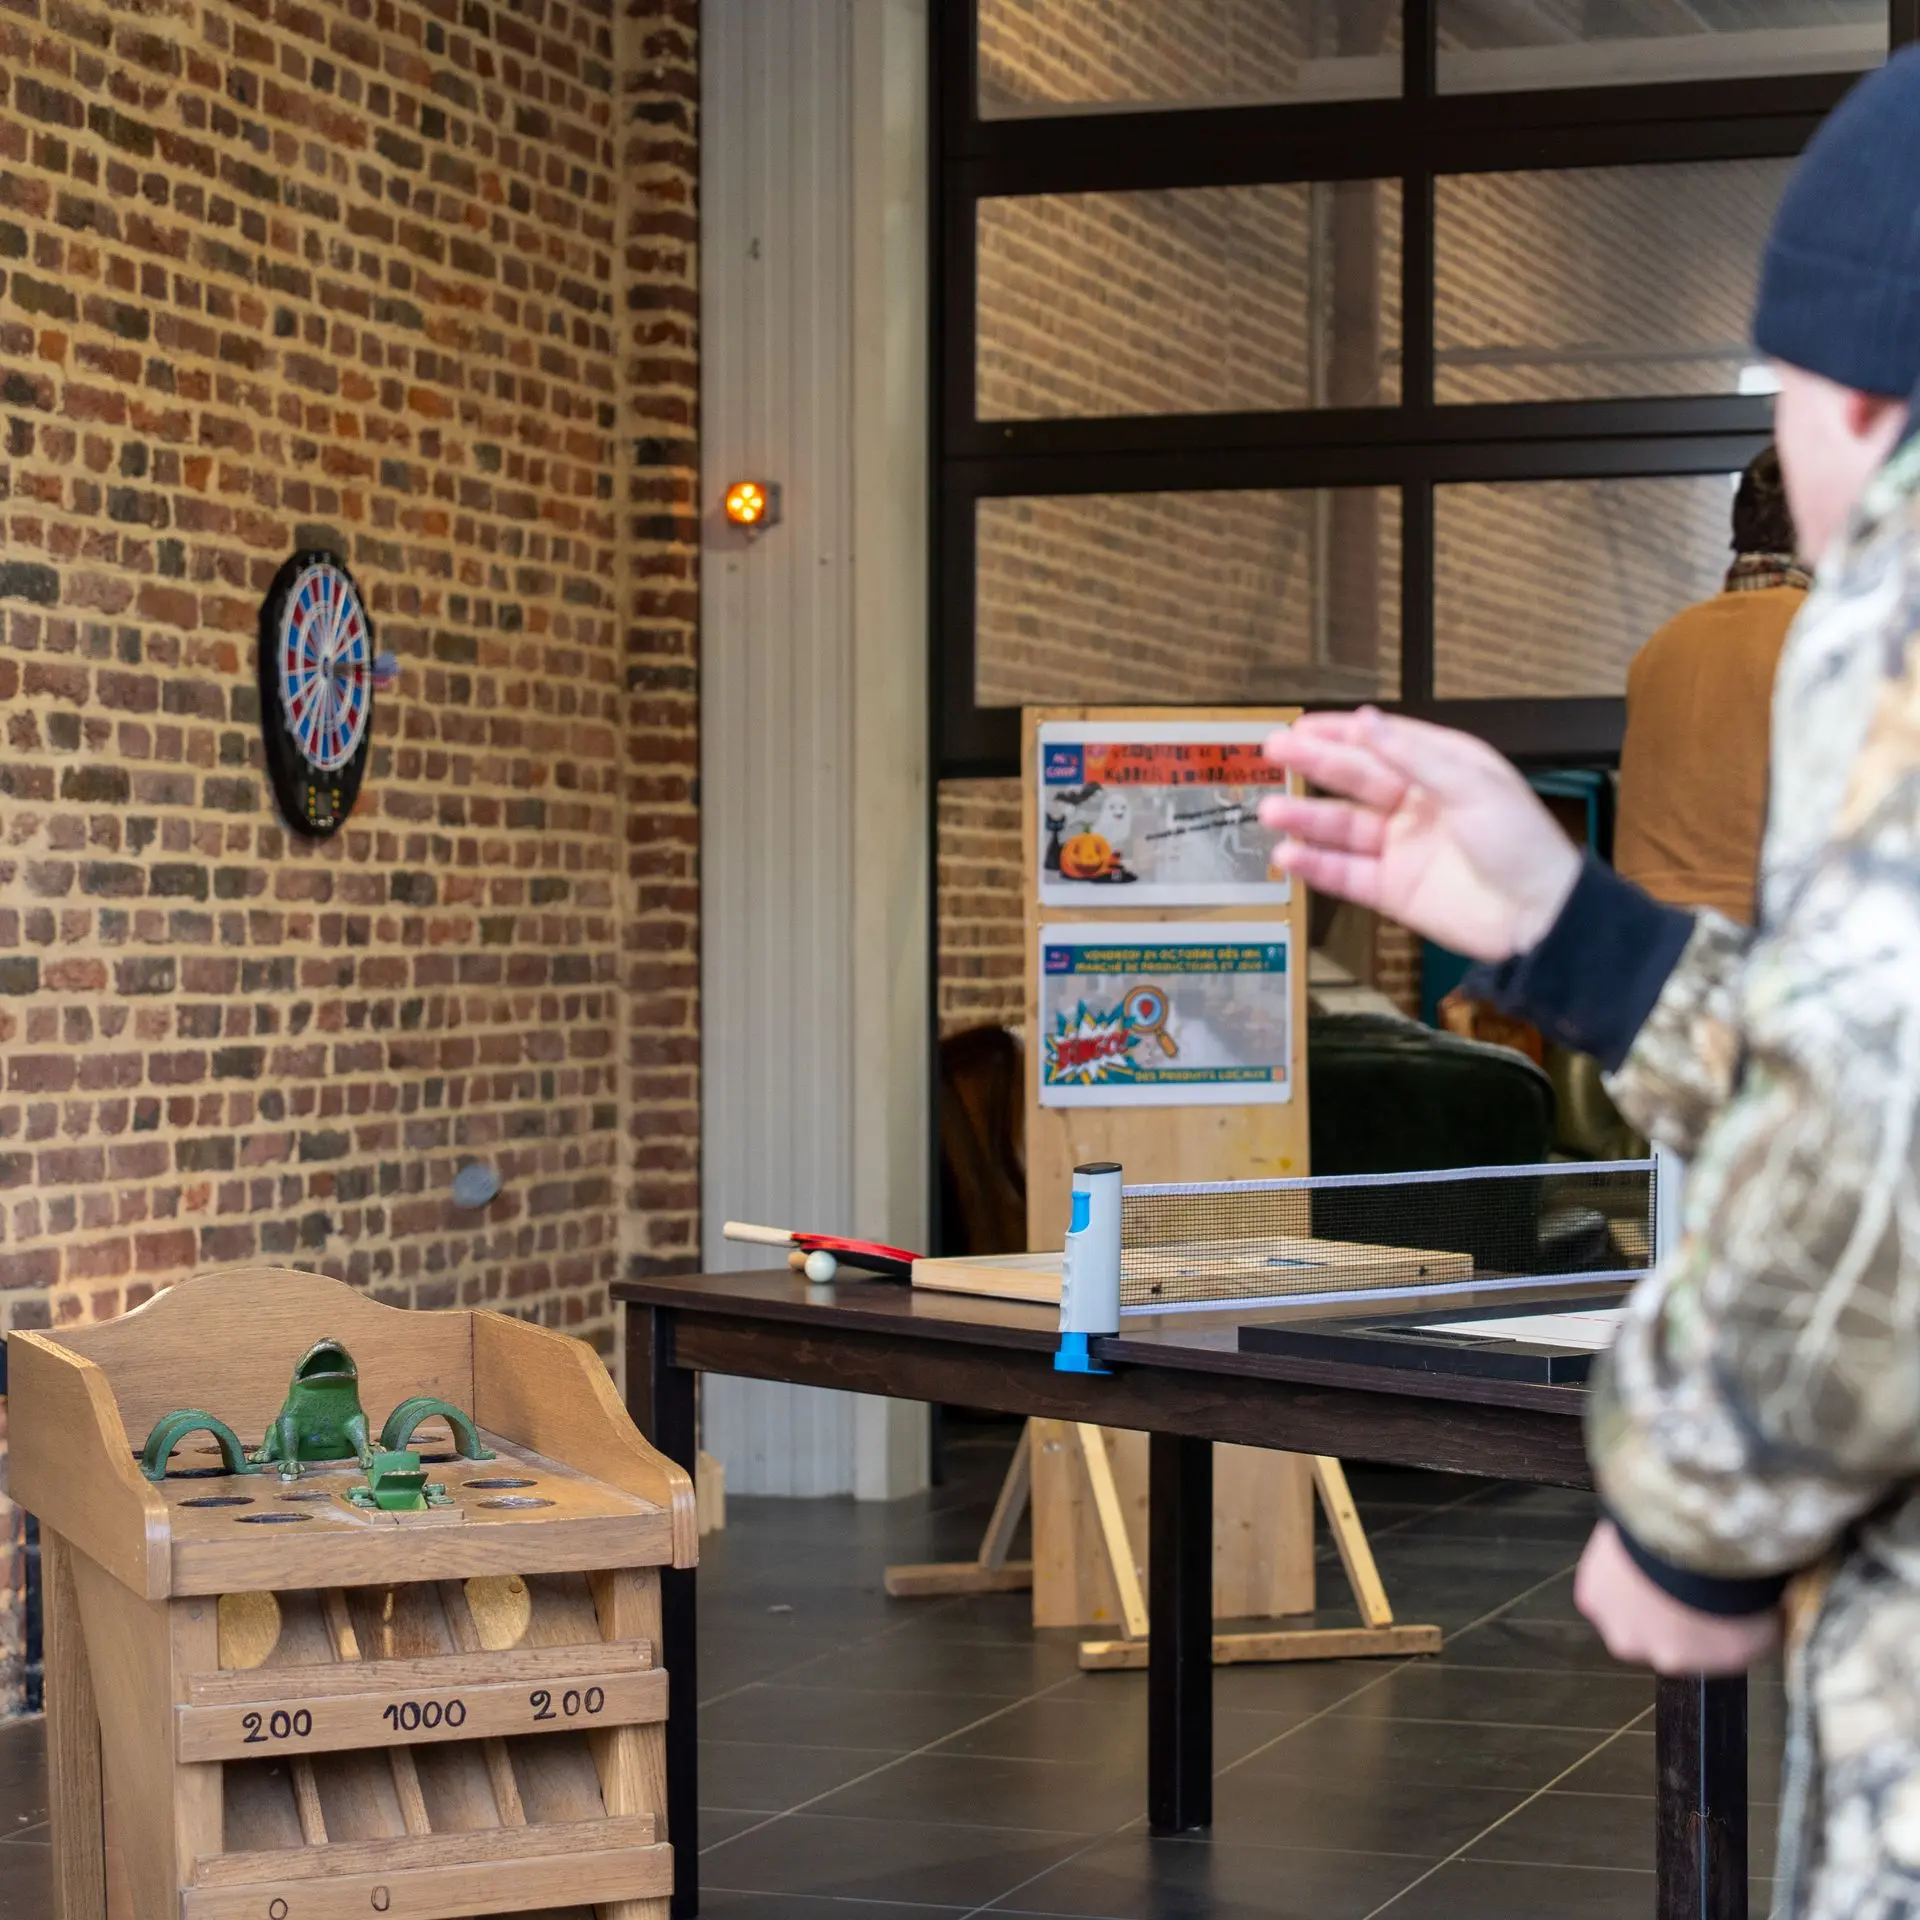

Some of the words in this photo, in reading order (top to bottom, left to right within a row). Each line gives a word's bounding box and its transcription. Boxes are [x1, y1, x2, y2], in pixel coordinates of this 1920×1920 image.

[242, 1708, 313, 1743] 200
[382, 1699, 467, 1731] 1000
[529, 1686, 605, 1721] 200
